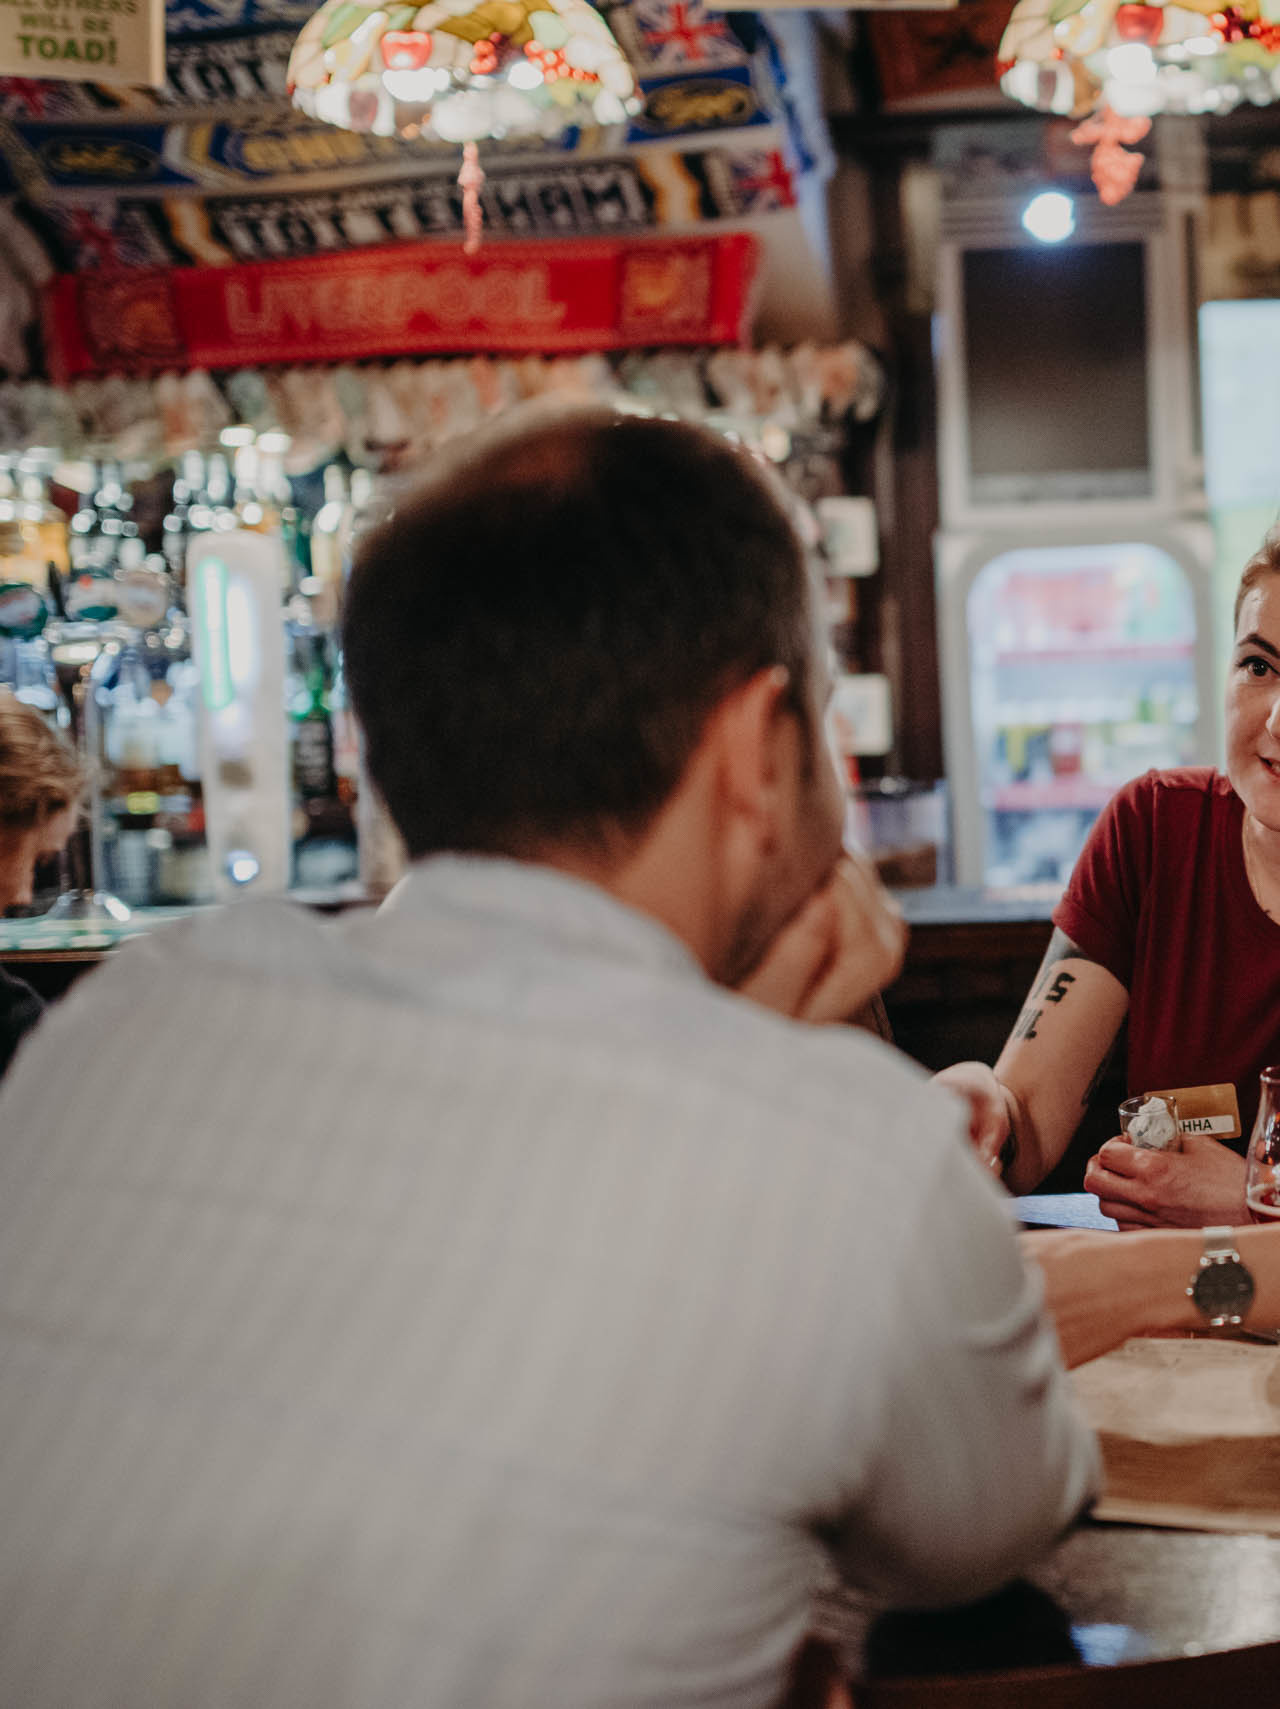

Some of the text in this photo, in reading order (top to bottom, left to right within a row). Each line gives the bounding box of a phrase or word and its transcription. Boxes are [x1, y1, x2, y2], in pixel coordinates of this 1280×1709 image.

[17, 34, 117, 66] TOAD!
[224, 264, 567, 338] LIVERPOOL
[1179, 1119, 1213, 1132] ННА
